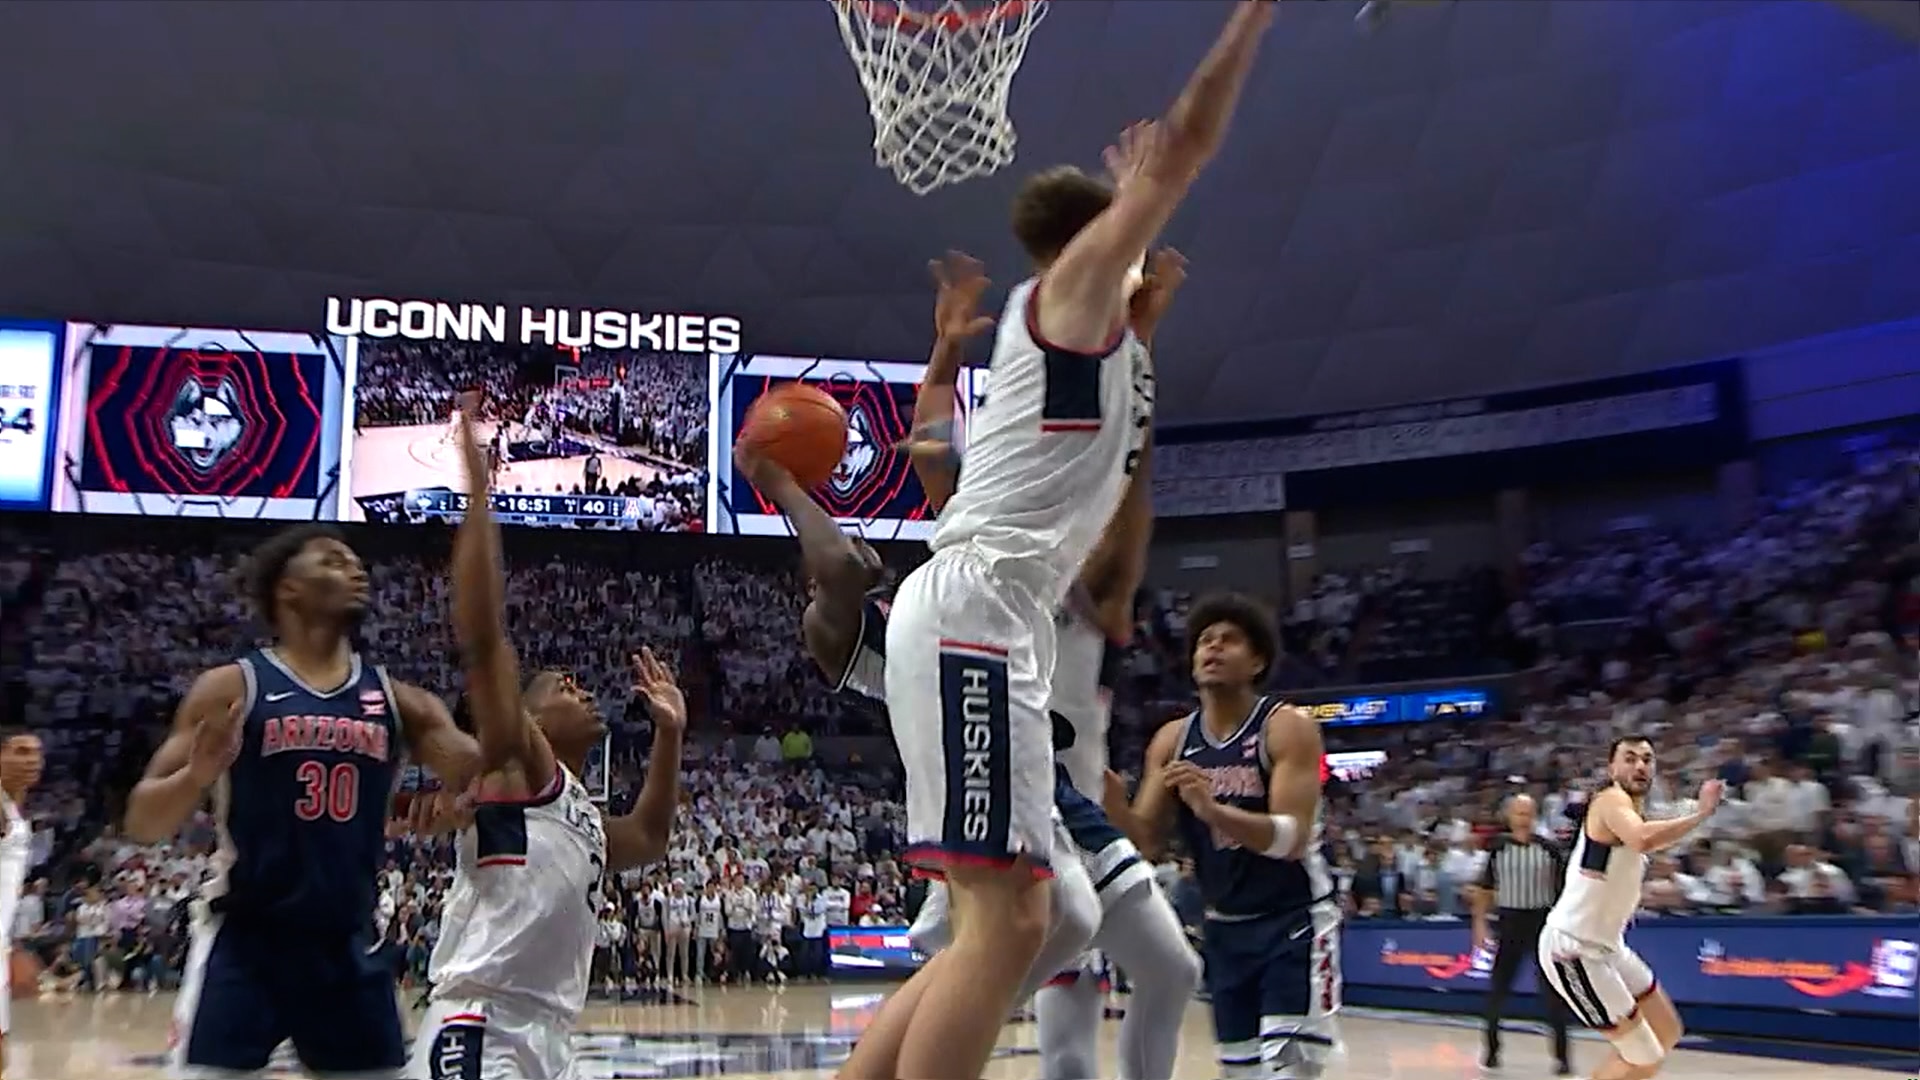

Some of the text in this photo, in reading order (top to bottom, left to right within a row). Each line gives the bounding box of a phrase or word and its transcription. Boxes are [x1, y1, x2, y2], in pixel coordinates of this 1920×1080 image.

[326, 297, 741, 353] UCONN HUSKIES
[508, 498, 550, 512] 16:51
[583, 500, 605, 513] 40
[261, 715, 388, 762] ARIZONA
[962, 668, 991, 841] HUSKIES
[294, 760, 360, 823] 30
[440, 1030, 465, 1080] HU
